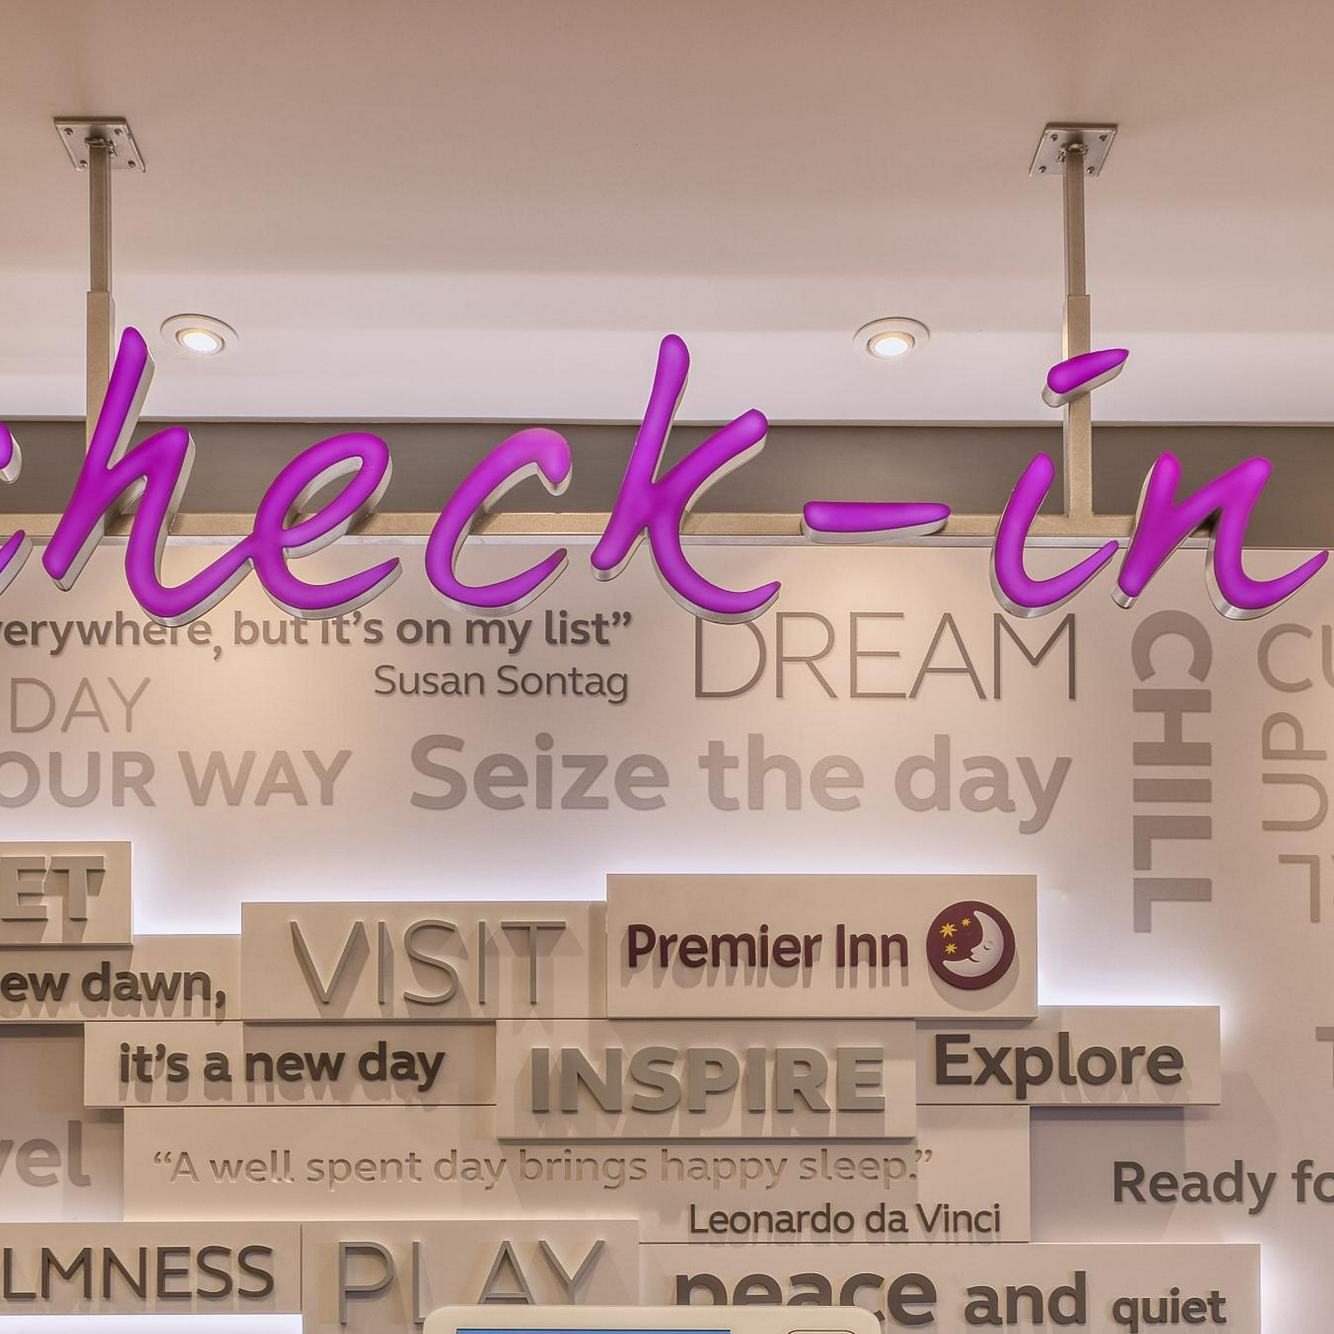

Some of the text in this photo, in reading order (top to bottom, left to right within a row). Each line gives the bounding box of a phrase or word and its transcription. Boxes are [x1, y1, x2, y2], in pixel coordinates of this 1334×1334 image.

[234, 611, 308, 645] but
[322, 611, 383, 645] it’s
[396, 619, 452, 645] on
[466, 619, 532, 653] my
[545, 611, 632, 646] list”
[694, 612, 1076, 699] DREAM
[10, 677, 151, 734] DAY
[374, 666, 628, 704] Susan Sontag
[177, 750, 352, 807] WAY
[411, 731, 1072, 834] Seize the day
[1132, 610, 1213, 933] CHILL
[1261, 712, 1329, 832] UP
[289, 919, 566, 1005] VISIT
[628, 924, 908, 968] Premier Inn
[82, 962, 226, 1009] dawn,
[120, 1041, 445, 1092] it’s a new day
[531, 1046, 886, 1113] INSPIRE
[935, 1031, 1184, 1099] Explore
[153, 1149, 933, 1192] “A well spent day brings happy sleep.”
[1113, 1160, 1277, 1213] Ready
[689, 1203, 1001, 1234] Leonardo da Vinci
[339, 1240, 606, 1324] PLAY
[964, 1271, 1087, 1325] and
[1112, 1287, 1227, 1334] quiet
